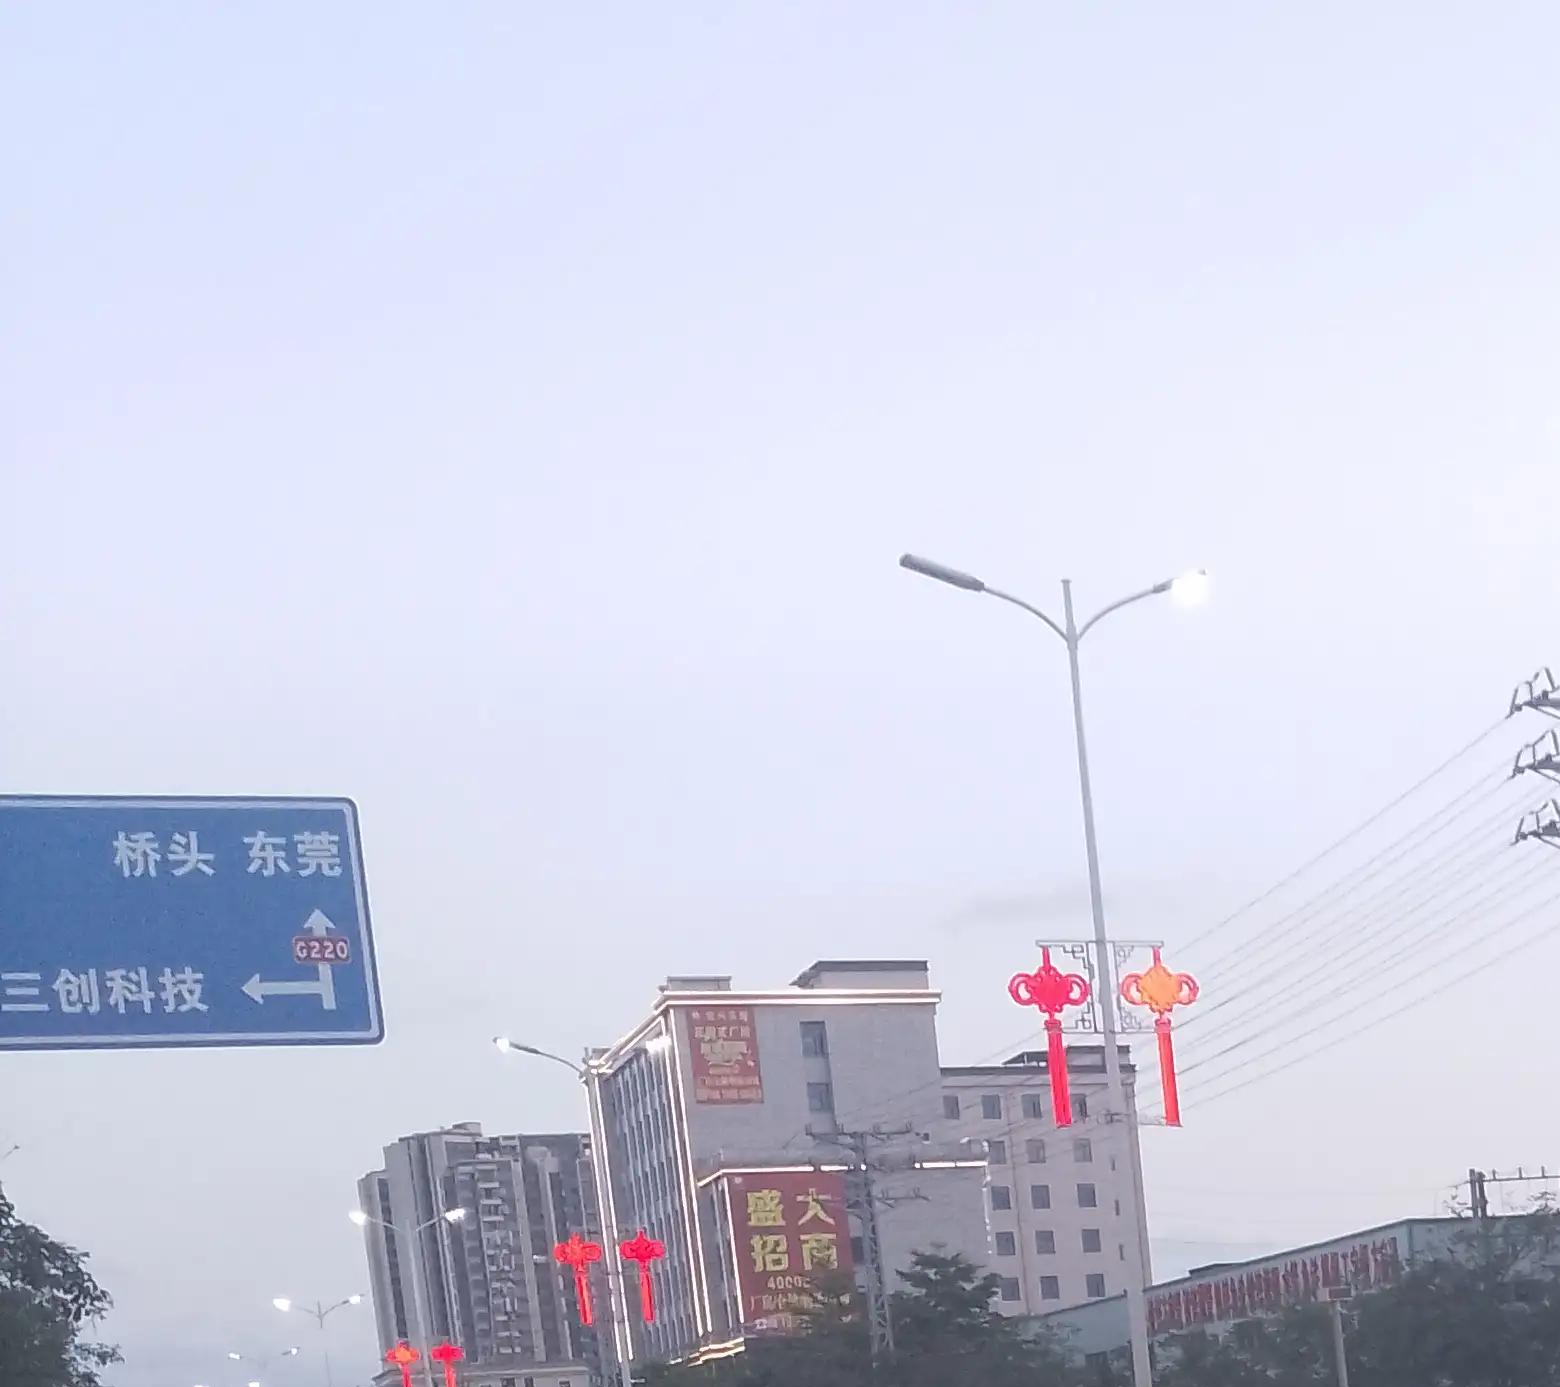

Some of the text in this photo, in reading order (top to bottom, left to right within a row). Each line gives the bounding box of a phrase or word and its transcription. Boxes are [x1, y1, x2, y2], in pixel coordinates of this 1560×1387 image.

[112, 830, 343, 878] 桥头 东莞
[296, 940, 349, 960] G220
[0, 966, 209, 1015] 三创科技
